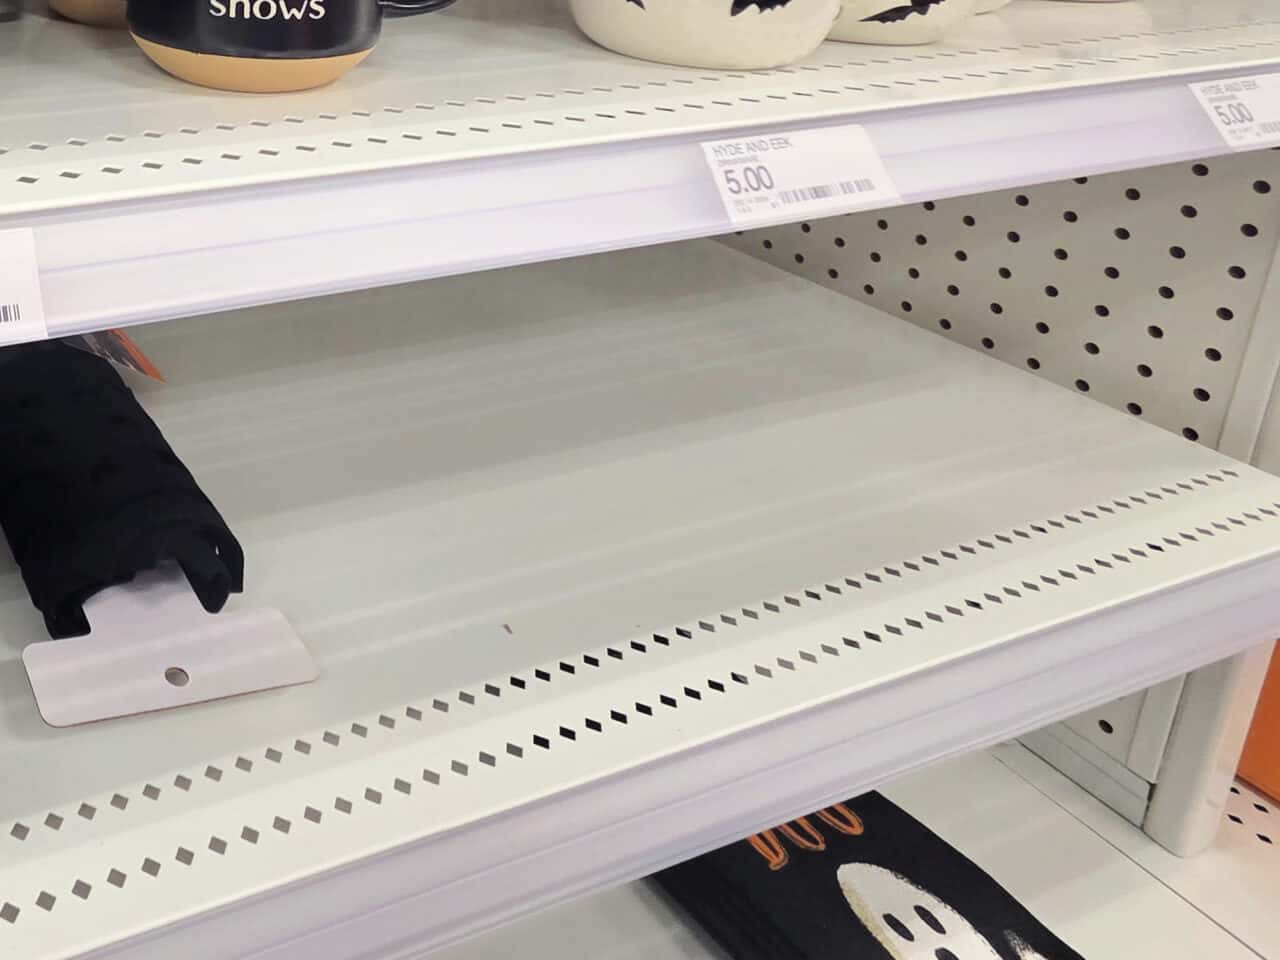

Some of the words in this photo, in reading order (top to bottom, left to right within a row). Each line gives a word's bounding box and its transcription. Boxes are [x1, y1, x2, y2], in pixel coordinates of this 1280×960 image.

[1213, 102, 1255, 126] 5.00
[713, 143, 745, 159] HYDE
[746, 139, 769, 154] AND
[770, 136, 793, 151] EEK
[723, 165, 775, 194] 5.00
